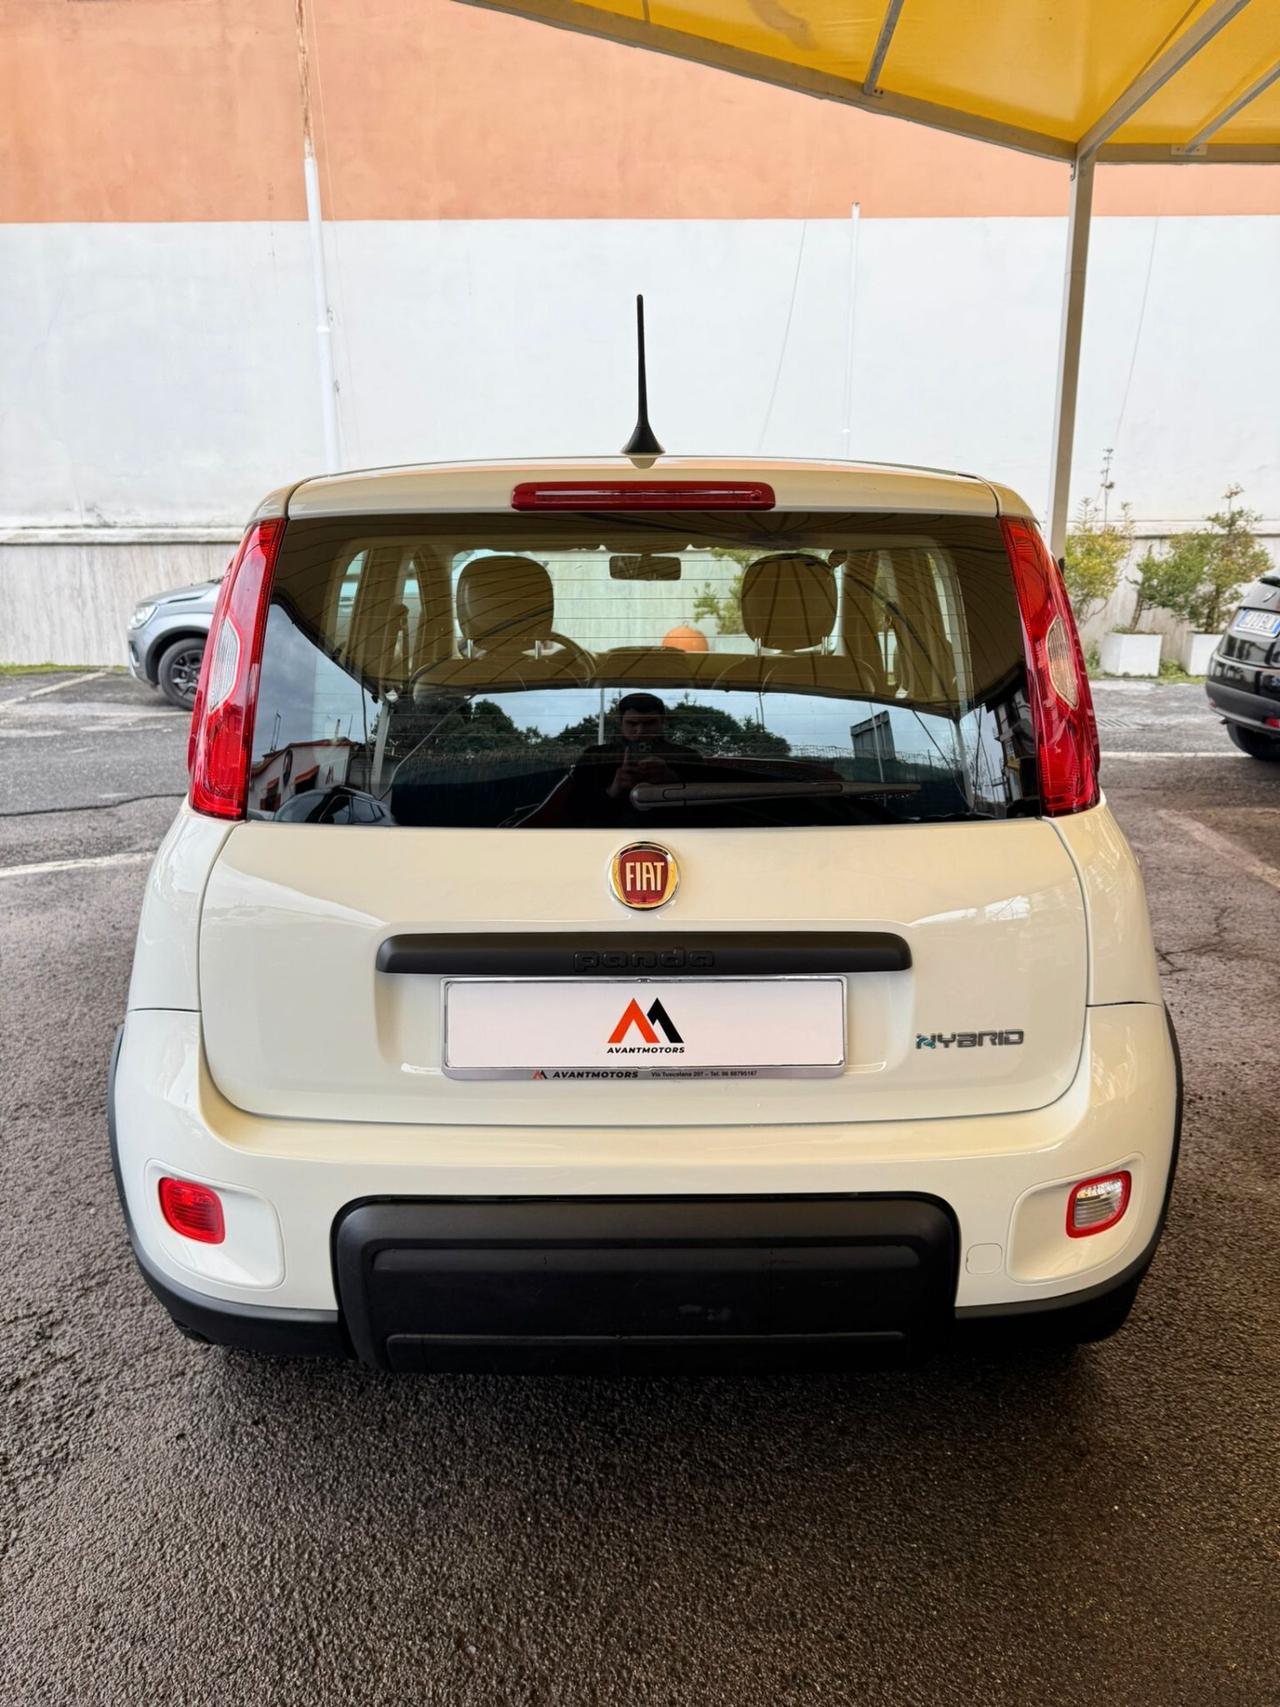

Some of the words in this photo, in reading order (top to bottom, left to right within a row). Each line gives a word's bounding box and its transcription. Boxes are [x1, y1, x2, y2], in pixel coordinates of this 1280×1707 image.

[625, 861, 665, 892] FIAT
[573, 947, 716, 973] panda
[606, 1046, 685, 1054] AVANTMOTORS
[916, 1029, 1024, 1050] HYBRID
[552, 1070, 639, 1079] AVANTMOTORS
